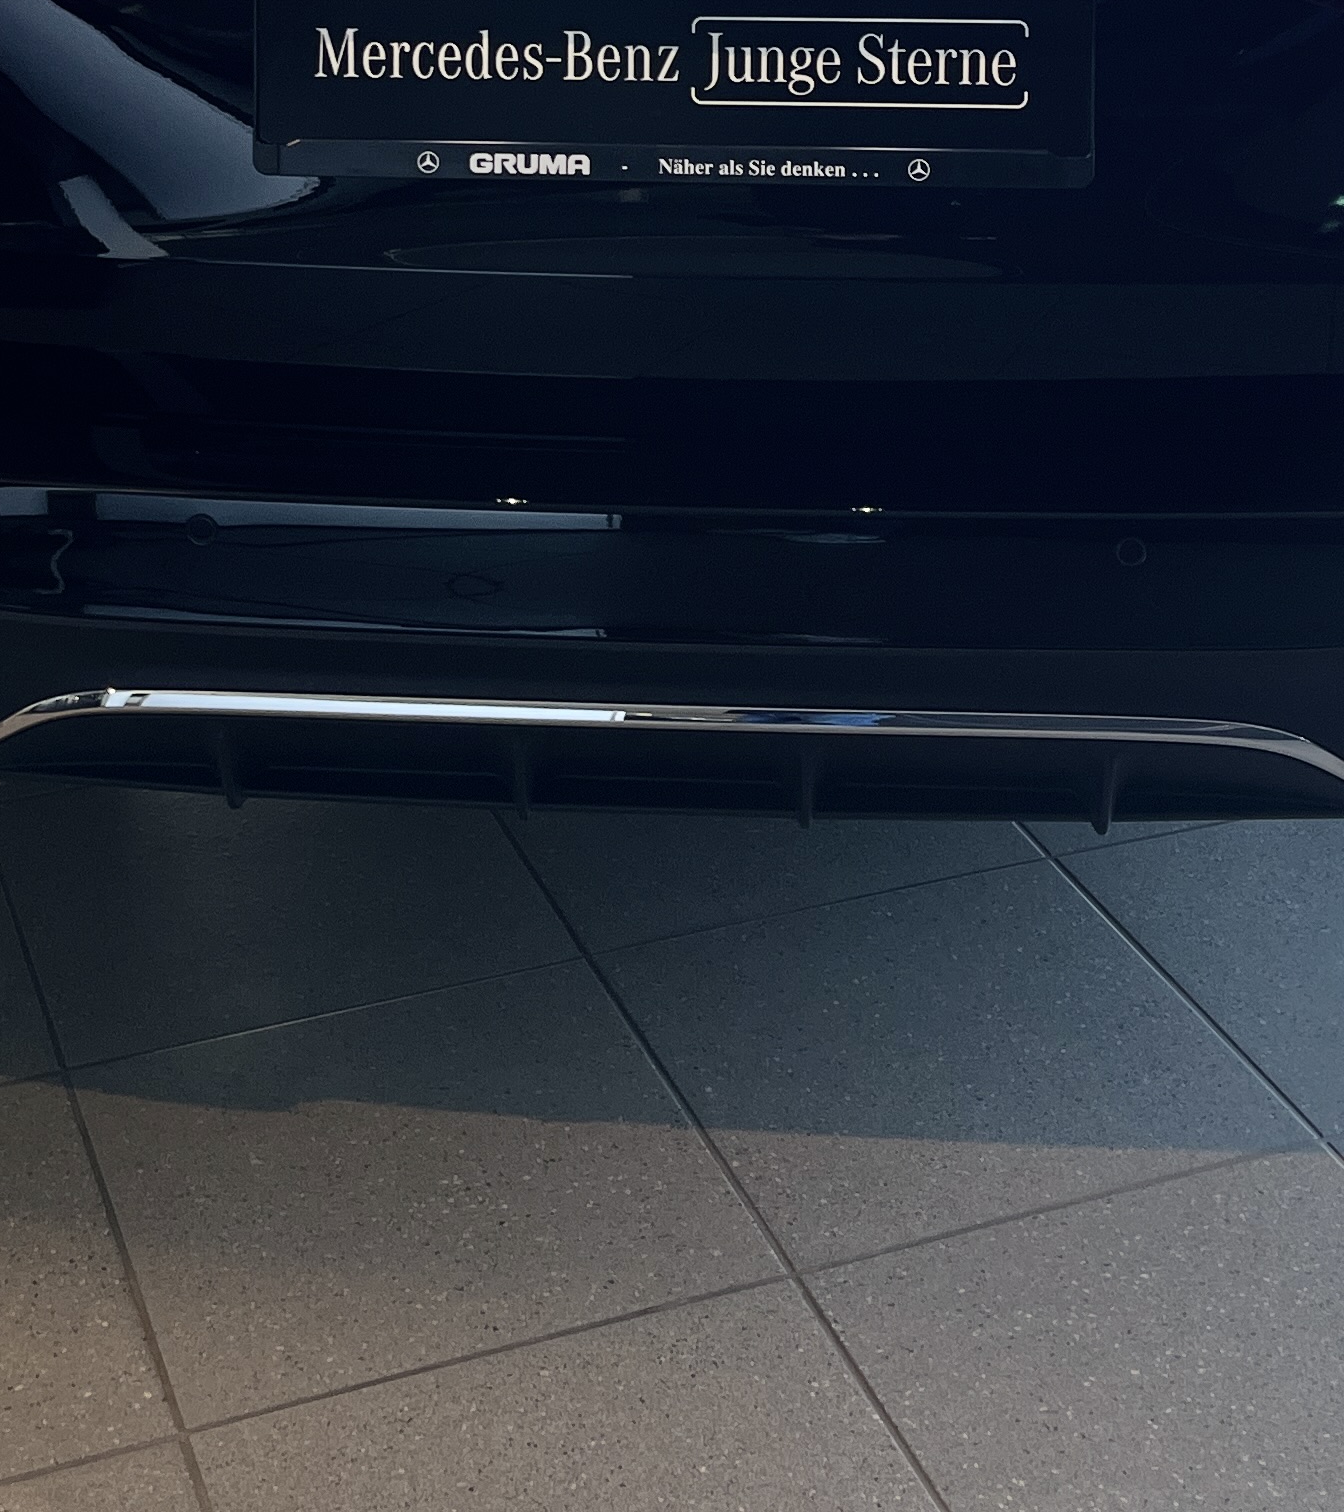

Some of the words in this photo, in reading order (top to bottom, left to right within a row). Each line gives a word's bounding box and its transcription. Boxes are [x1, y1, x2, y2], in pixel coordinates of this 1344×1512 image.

[313, 26, 681, 82] Mercedes-Benz
[703, 31, 842, 96] Junge
[856, 32, 1017, 87] Sterne
[469, 152, 591, 175] GRUMA
[658, 158, 714, 176] Näher
[718, 159, 744, 176] als
[748, 159, 776, 176] Sie
[780, 160, 846, 178] denken
